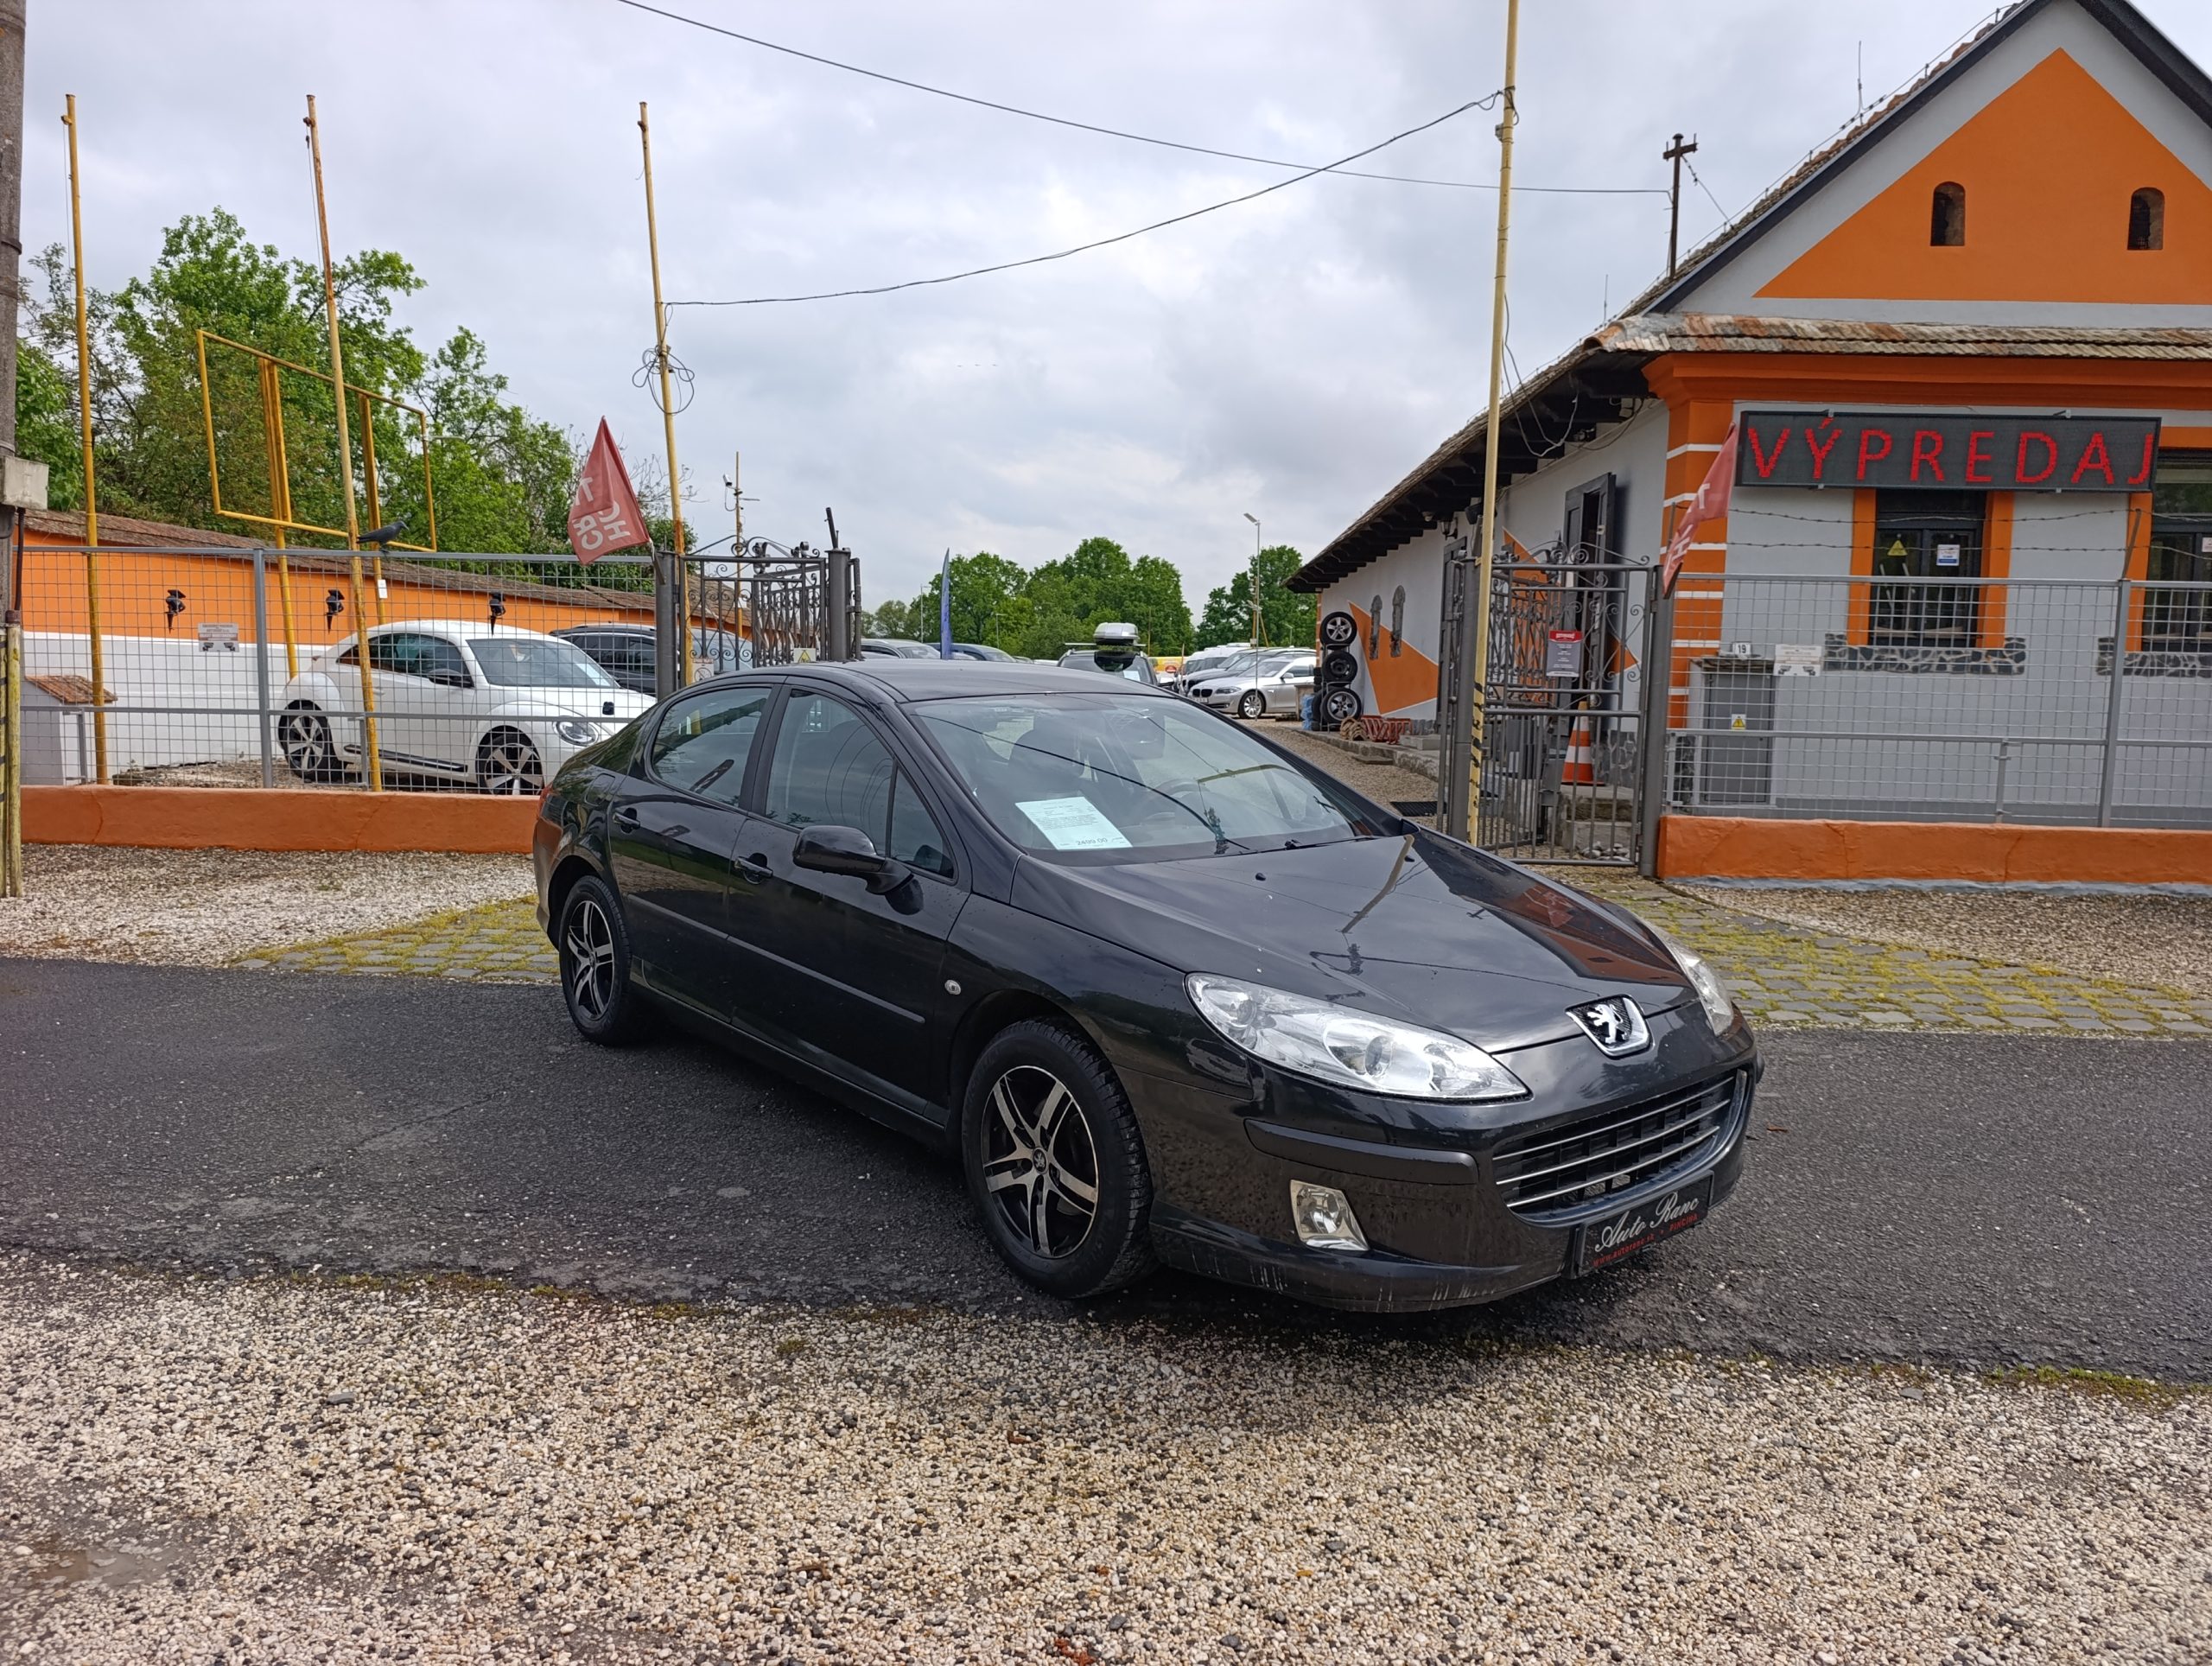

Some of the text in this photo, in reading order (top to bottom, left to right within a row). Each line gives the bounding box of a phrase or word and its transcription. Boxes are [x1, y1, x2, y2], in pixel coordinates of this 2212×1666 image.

[1747, 417, 2153, 485] VÝPREDAJ
[1738, 644, 1746, 654] 19
[1595, 1191, 1700, 1252] Auto Ranc
